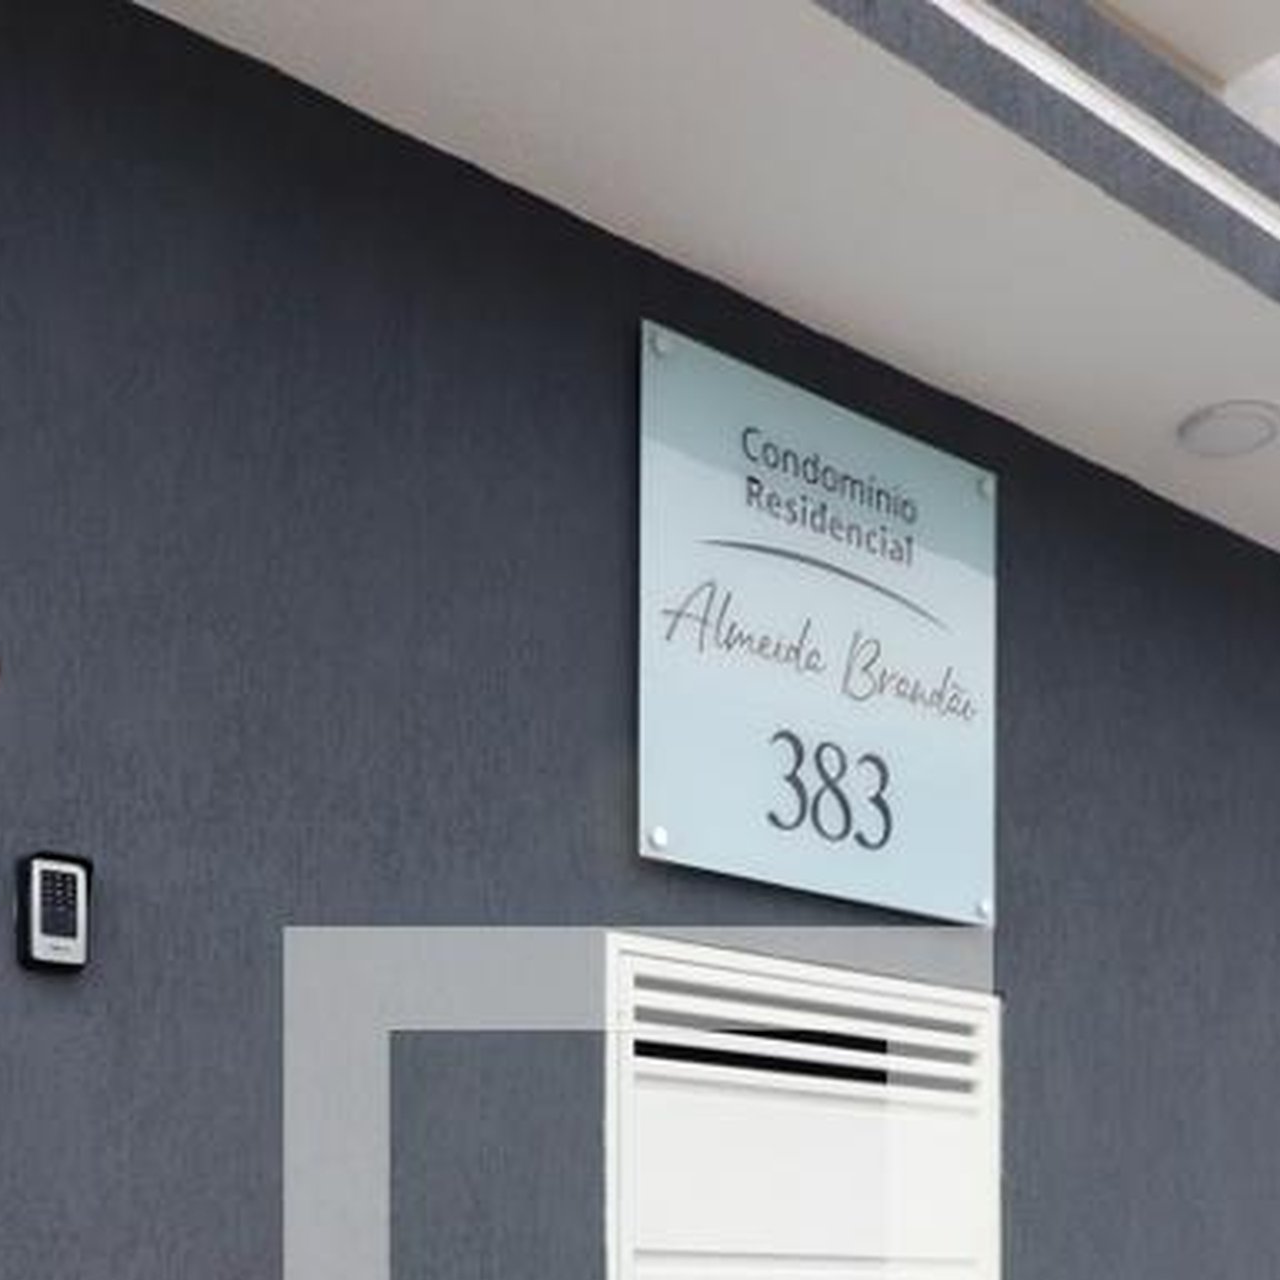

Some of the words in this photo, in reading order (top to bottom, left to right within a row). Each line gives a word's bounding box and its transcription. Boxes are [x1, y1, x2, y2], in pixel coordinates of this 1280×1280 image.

[746, 475, 913, 566] Residencial
[660, 580, 828, 675] Almeida
[767, 731, 892, 850] 383
